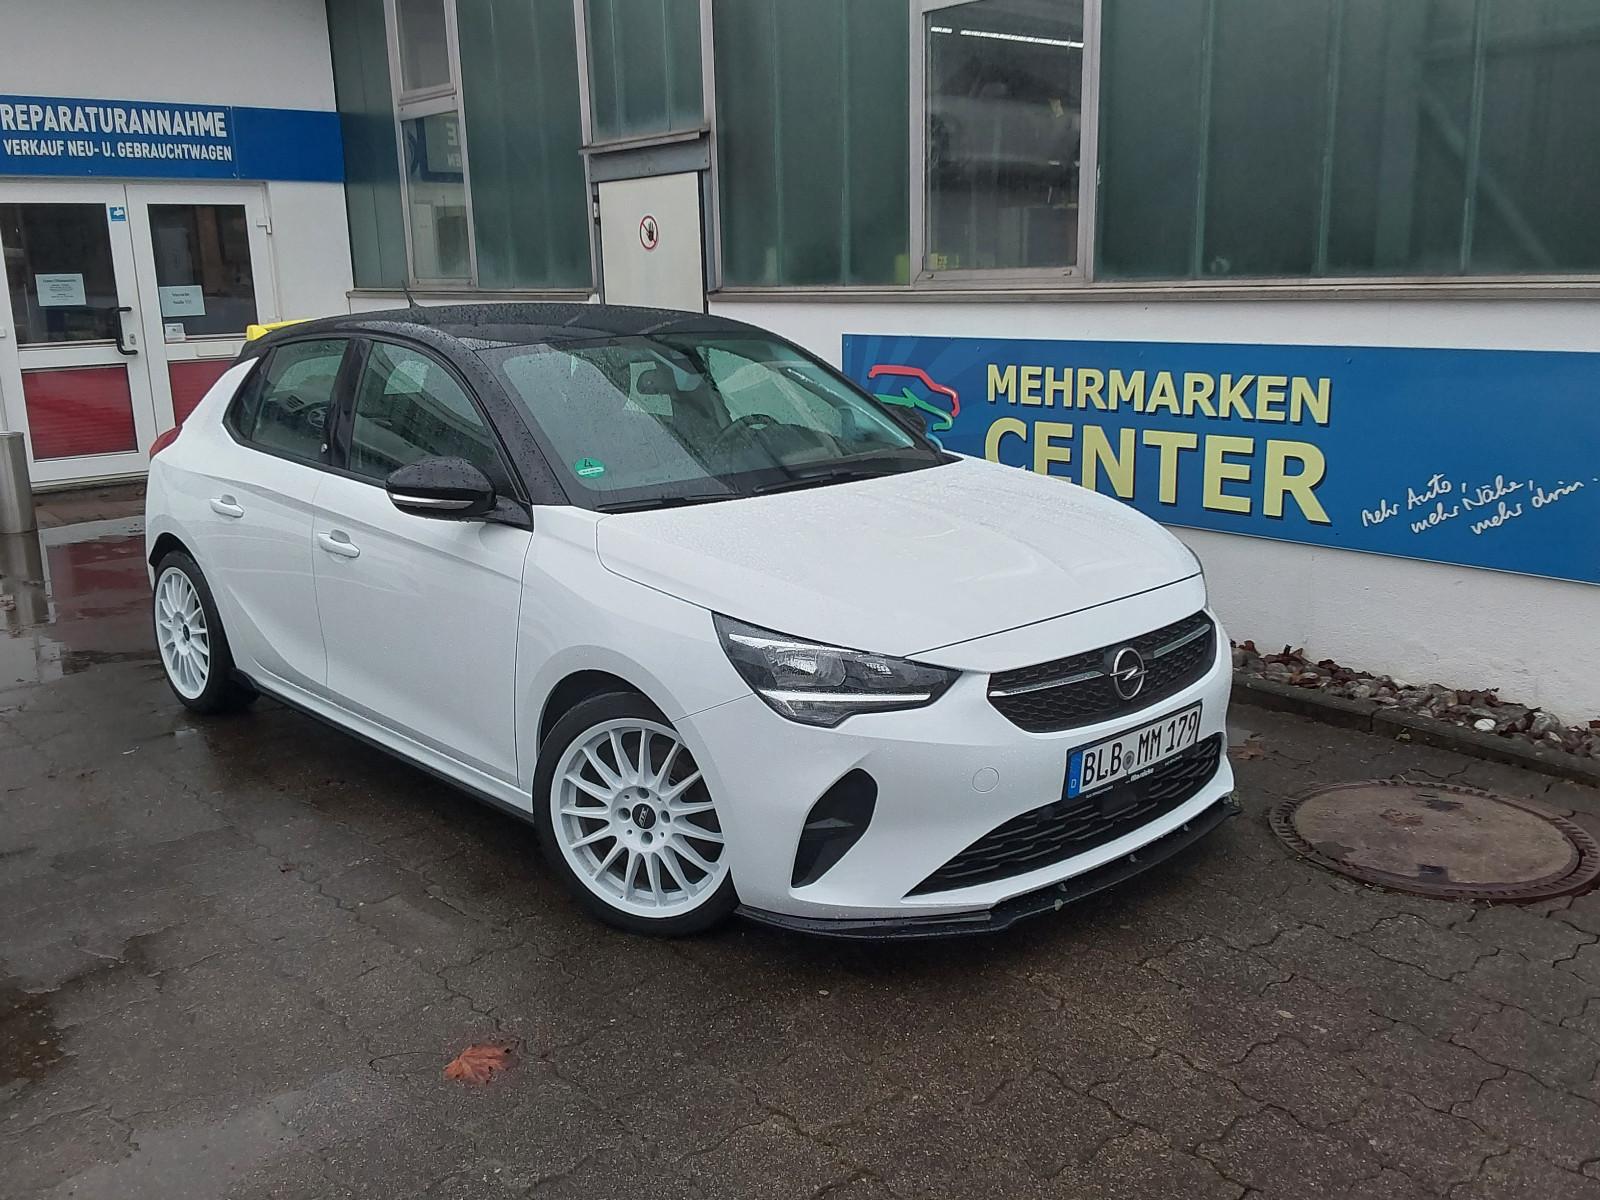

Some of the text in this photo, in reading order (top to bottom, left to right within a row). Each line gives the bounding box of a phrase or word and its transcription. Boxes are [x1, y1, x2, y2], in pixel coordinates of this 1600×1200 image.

[0, 103, 228, 138] REPARATURANNAHME
[3, 139, 233, 162] VERKAUF NEU- U. GEBRAUCHTWAGEN
[986, 363, 1332, 426] MEHRMARKEN
[984, 416, 1333, 524] CENTER
[1411, 502, 1459, 534] mehr
[1469, 501, 1523, 535] mehr
[1081, 741, 1123, 788] BLB
[1137, 725, 1162, 765] MM
[1165, 711, 1197, 753] 179
